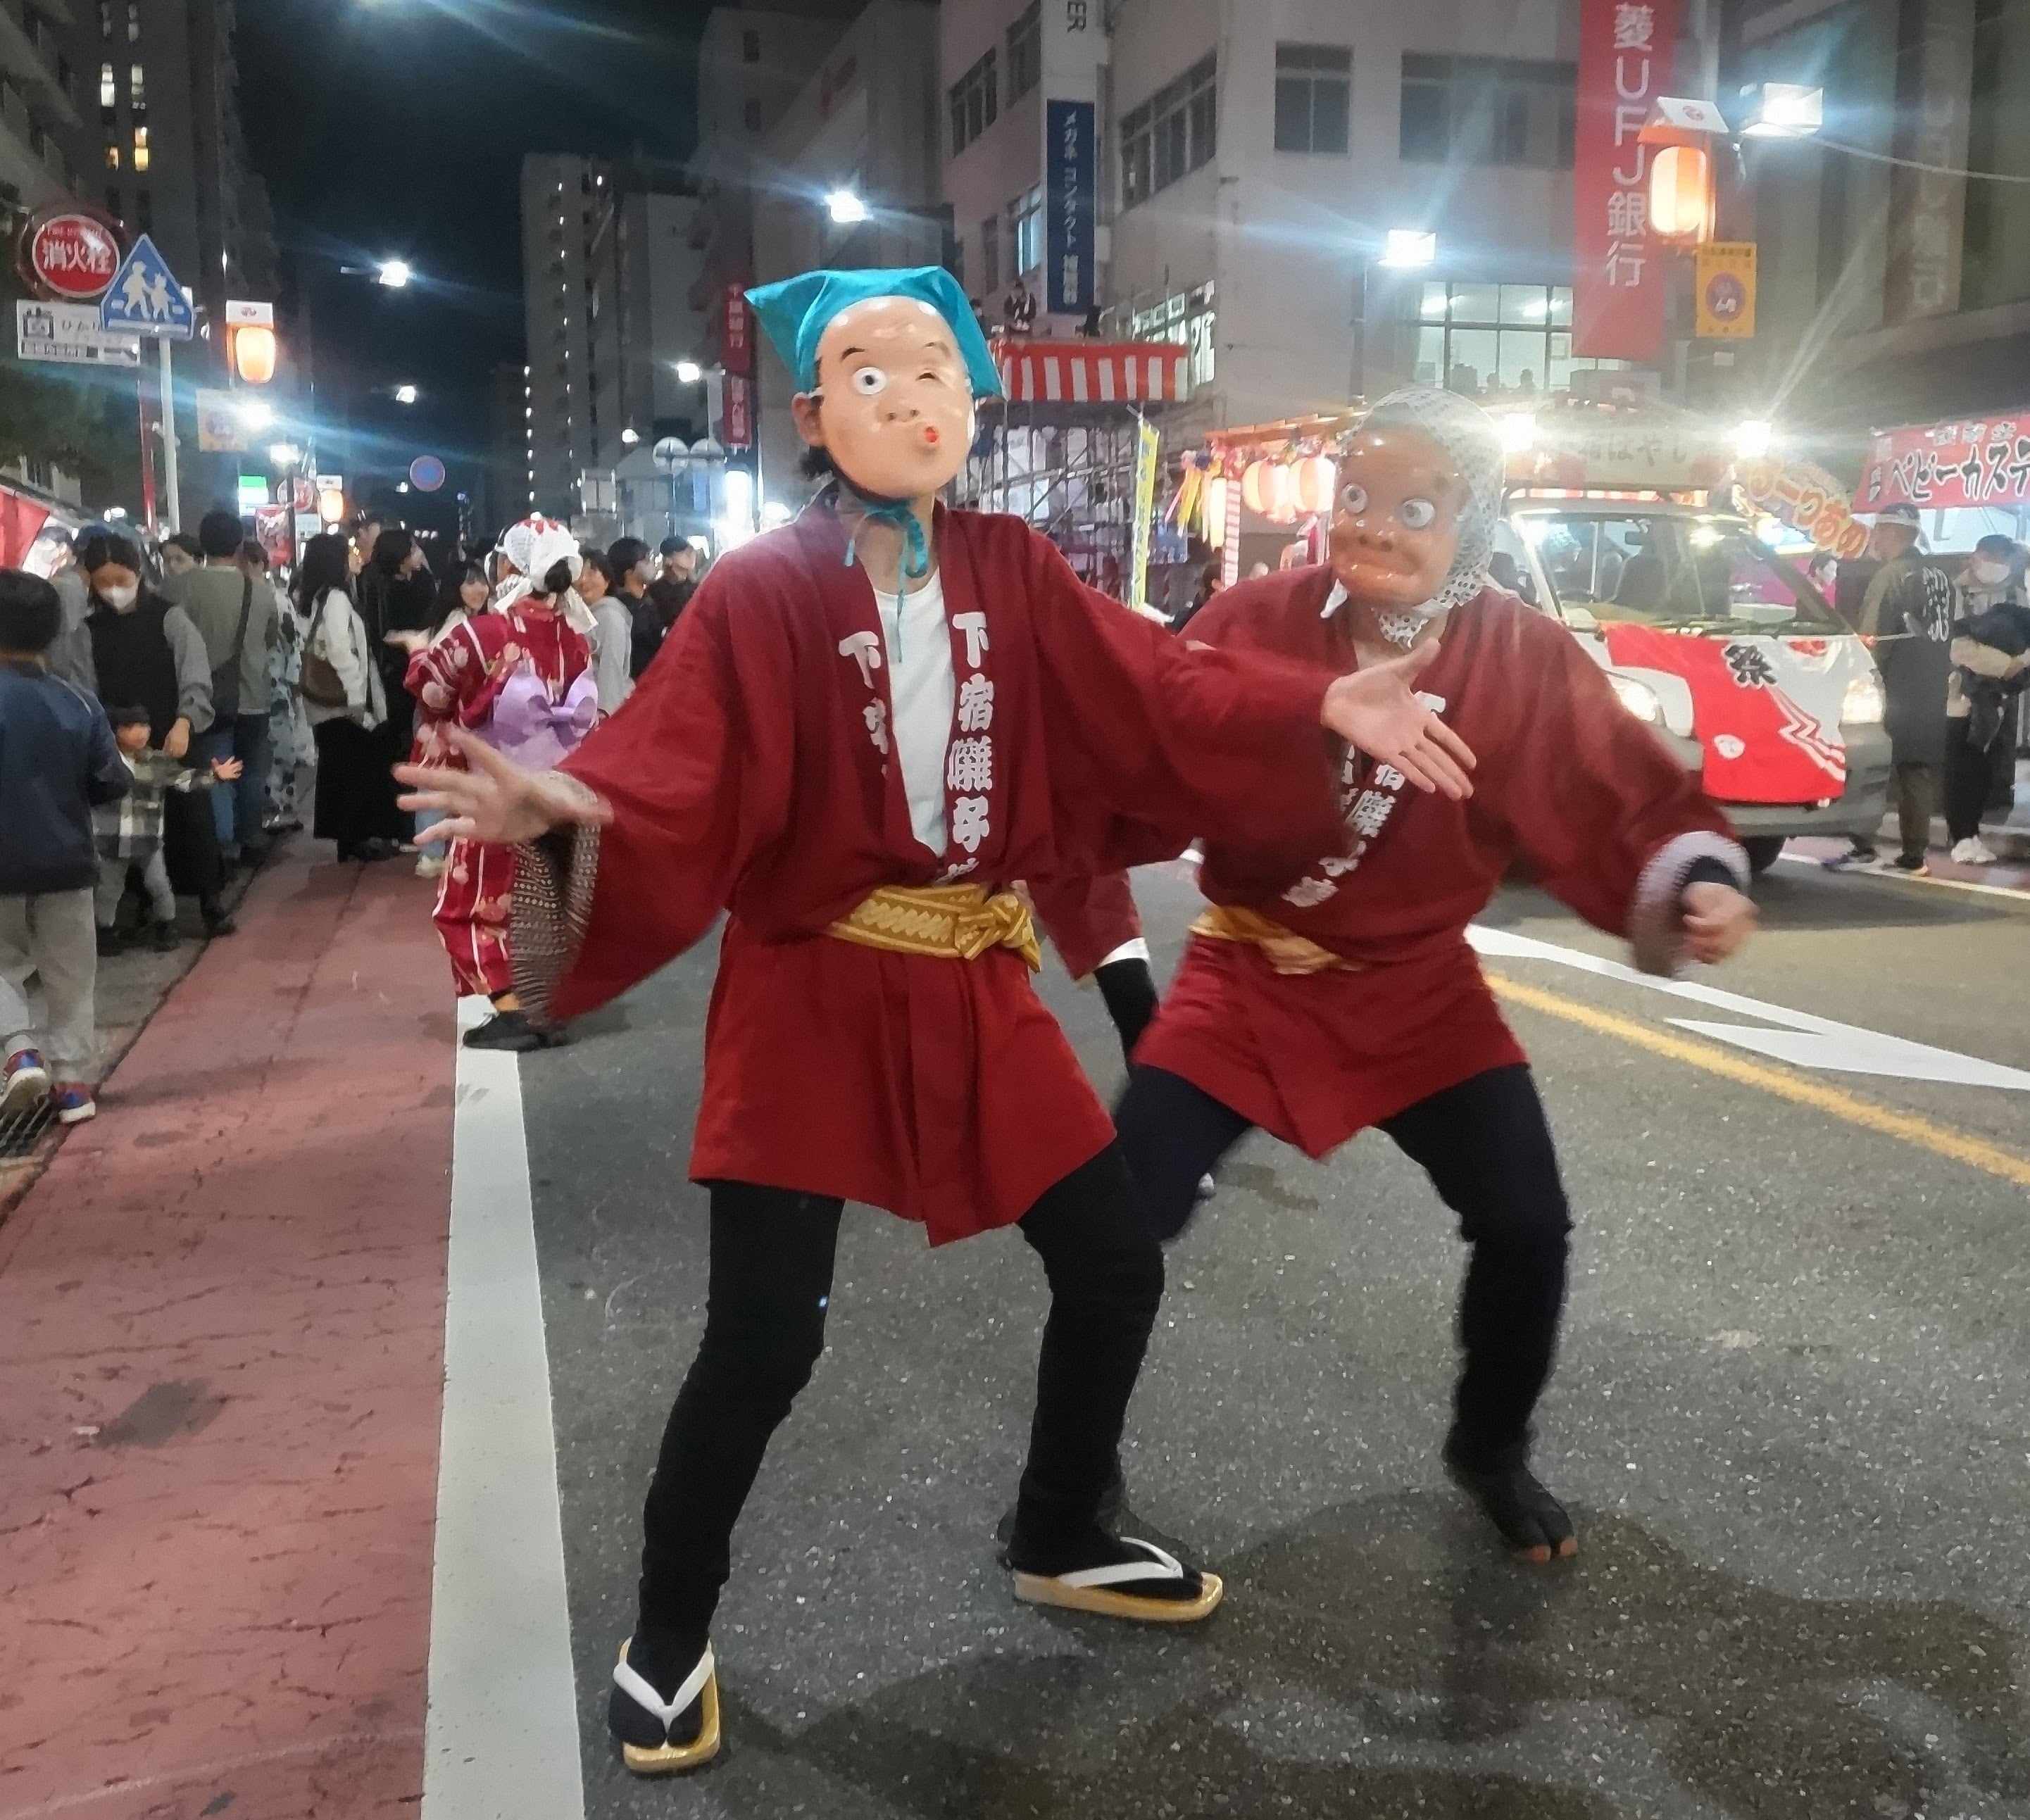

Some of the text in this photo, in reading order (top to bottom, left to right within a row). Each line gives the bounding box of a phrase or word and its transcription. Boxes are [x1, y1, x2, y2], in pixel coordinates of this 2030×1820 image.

[1067, 1, 1086, 32] ER
[1606, 4, 1654, 287] 菱UFJ銀行
[42, 237, 111, 275] 消火栓
[1723, 643, 1777, 686] 祭
